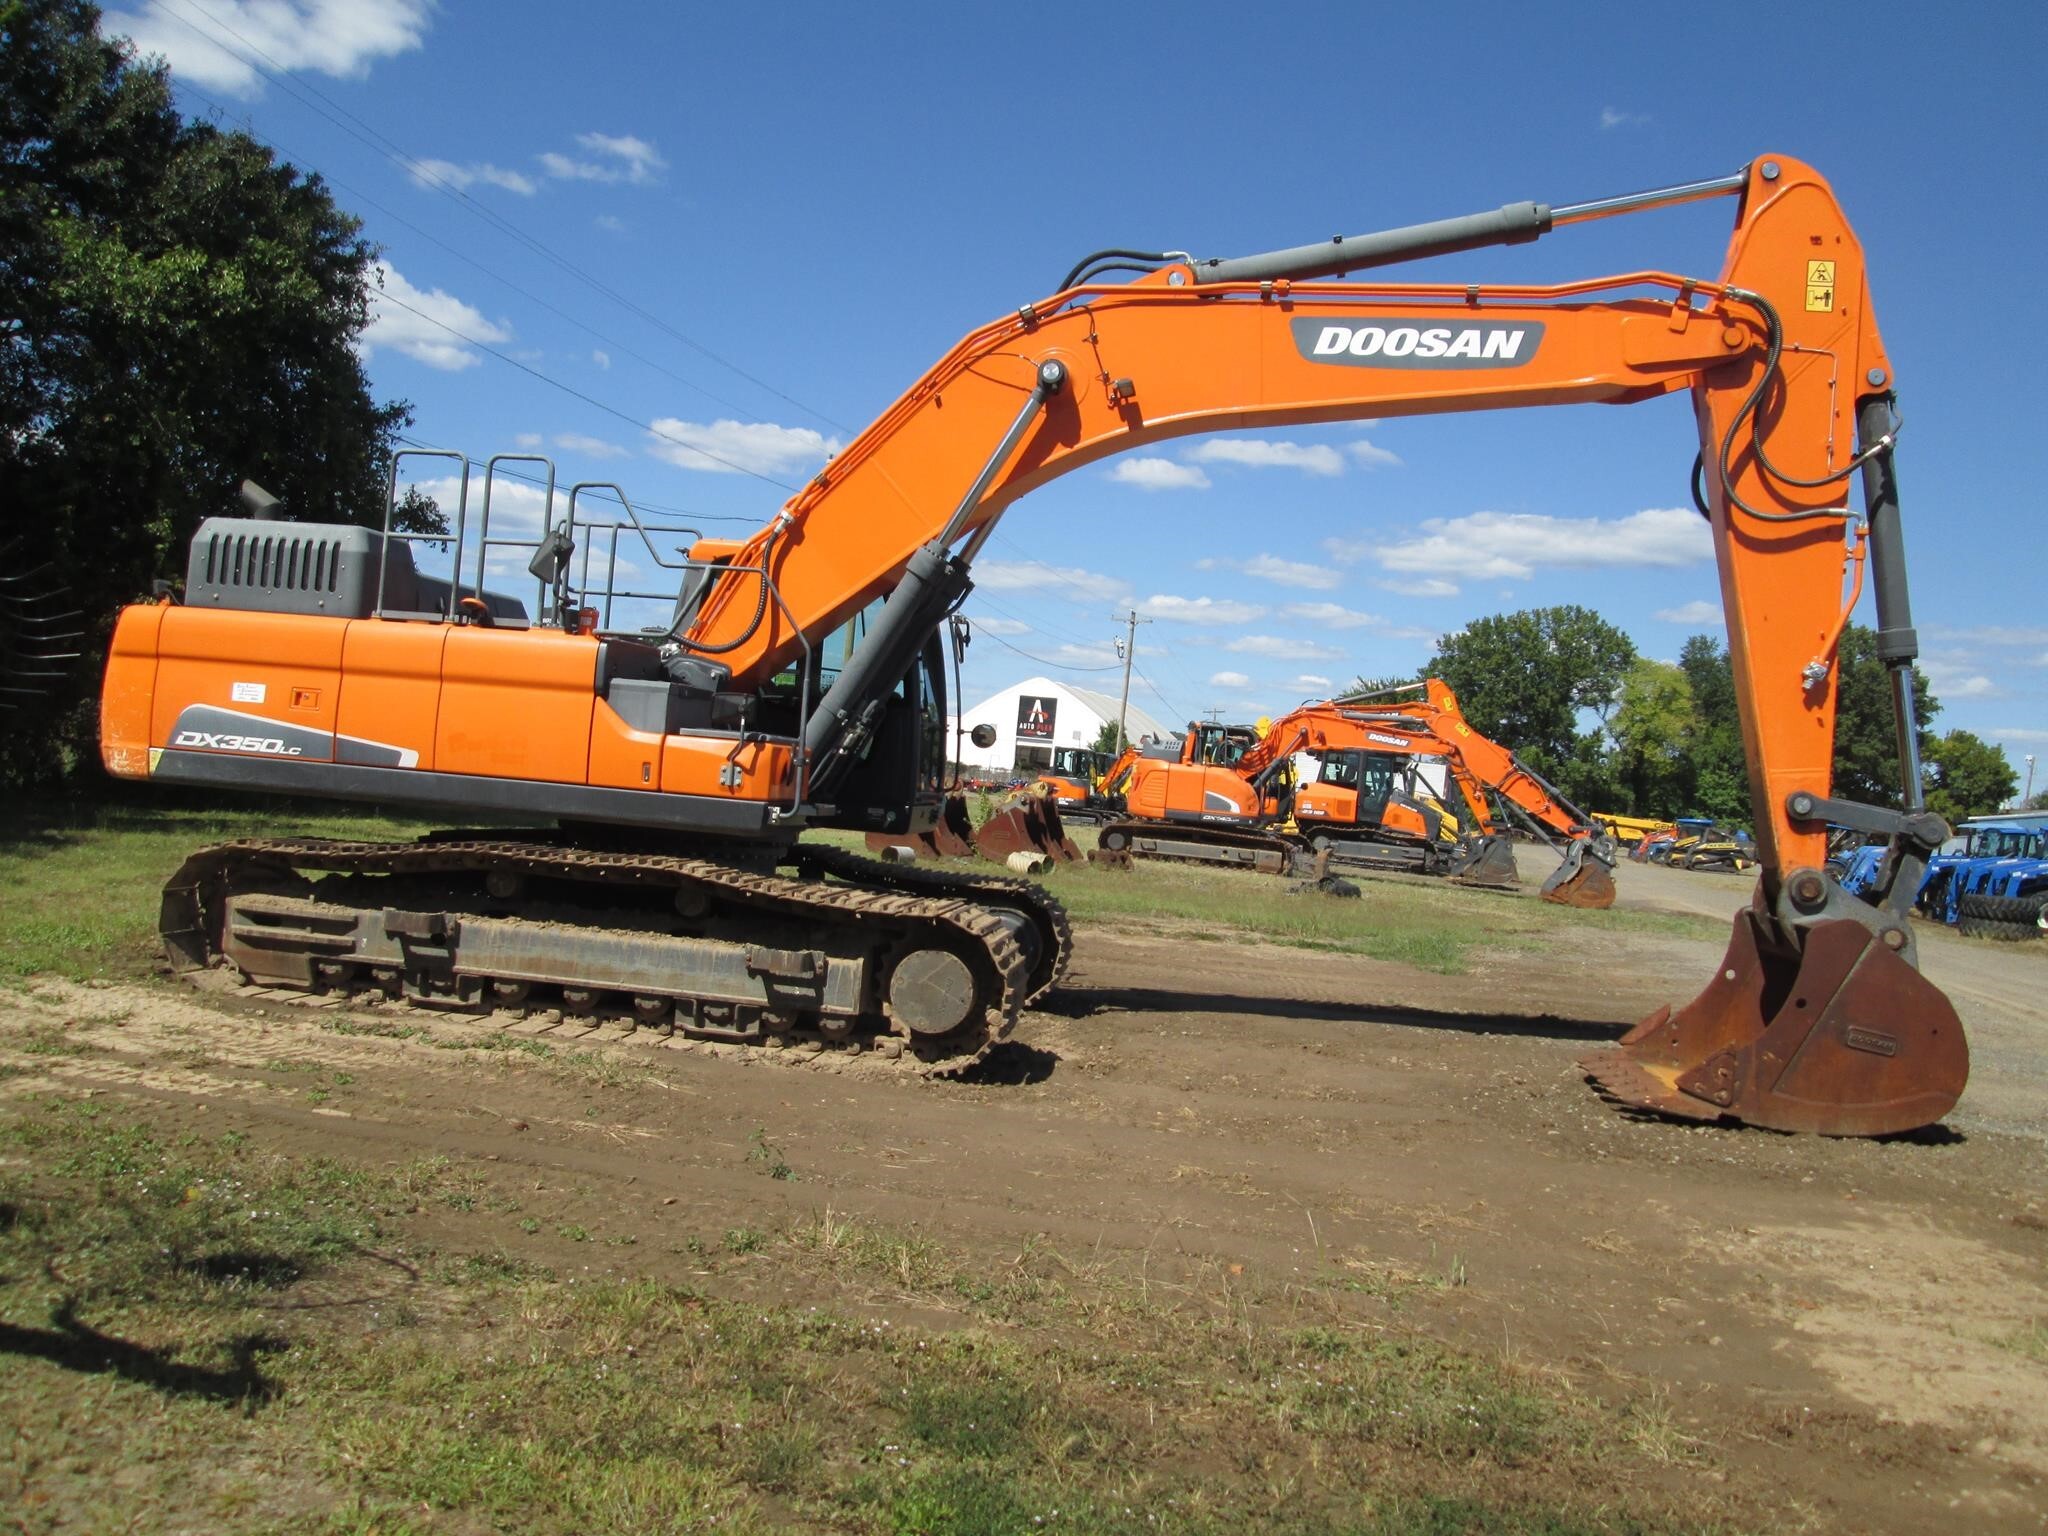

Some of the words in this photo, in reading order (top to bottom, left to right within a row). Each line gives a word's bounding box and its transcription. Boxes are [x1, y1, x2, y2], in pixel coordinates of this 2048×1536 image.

[1313, 327, 1525, 359] DOOSAN
[1019, 722, 1035, 730] AUTO
[1368, 733, 1409, 747] DOOSAN
